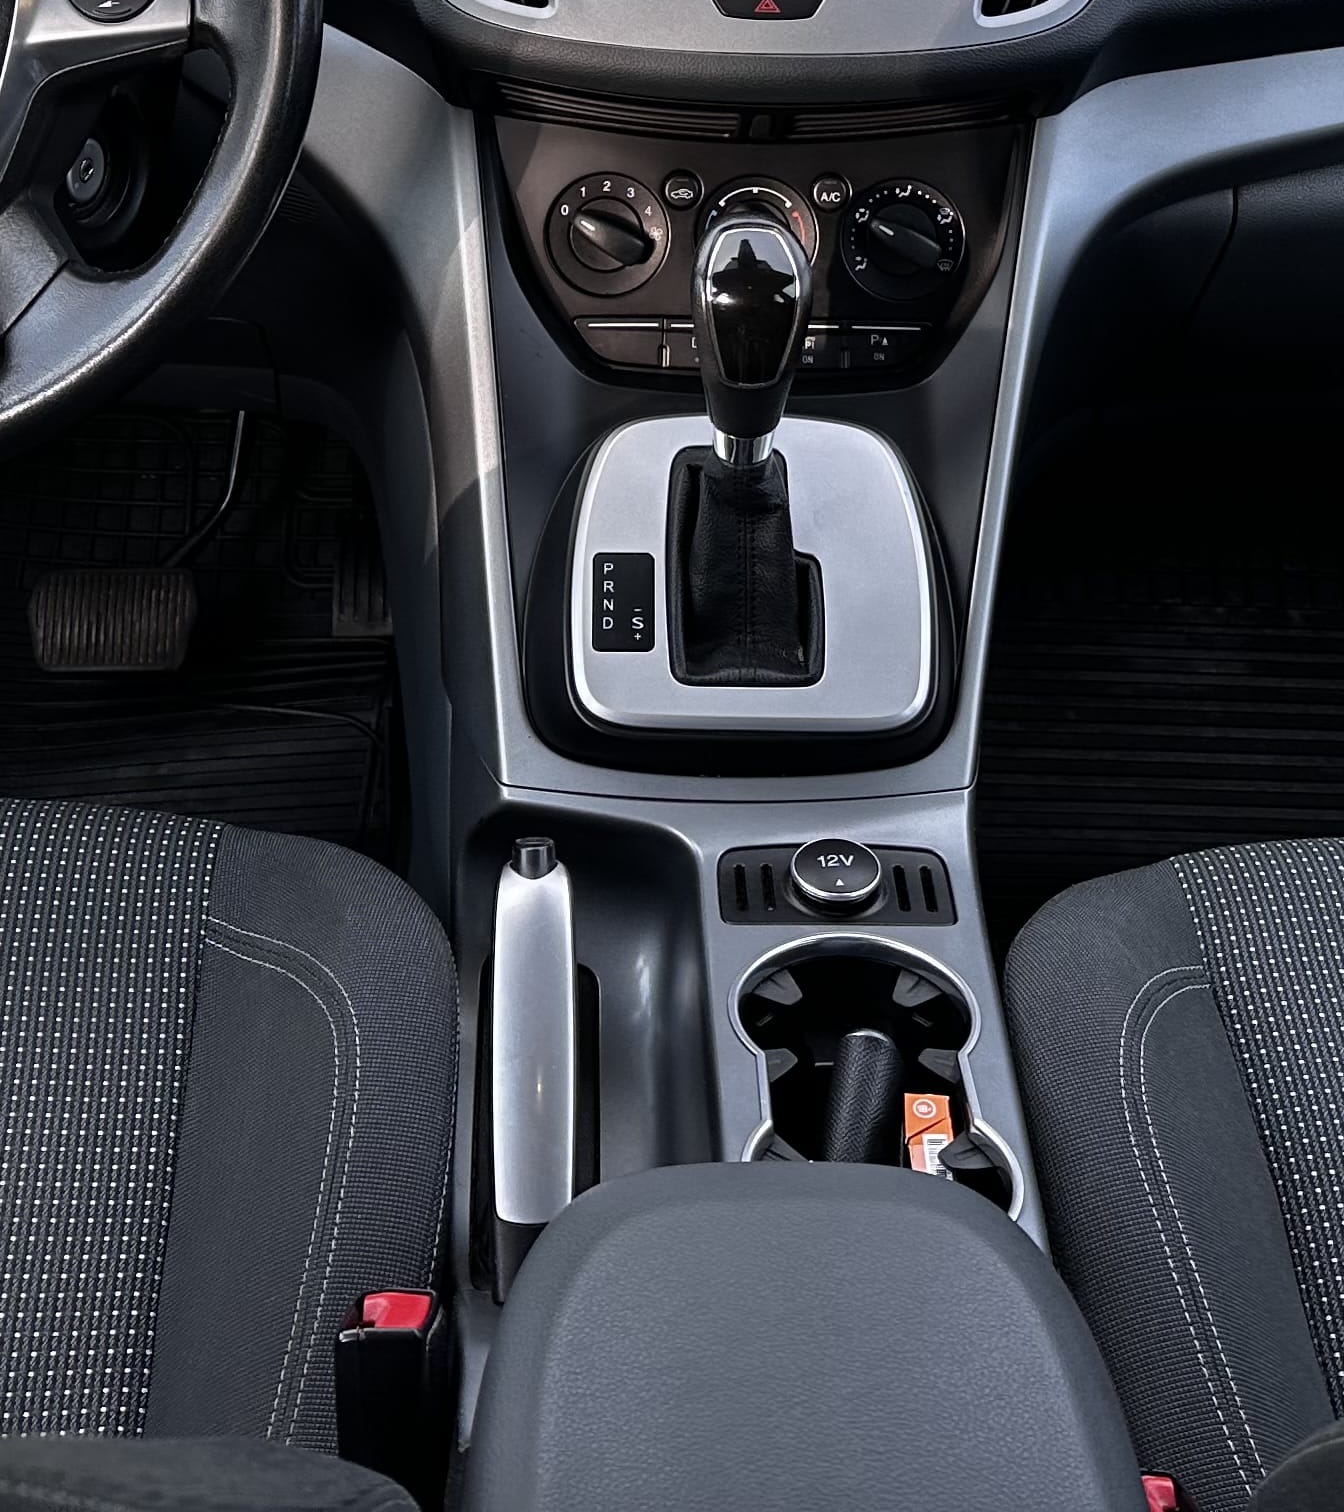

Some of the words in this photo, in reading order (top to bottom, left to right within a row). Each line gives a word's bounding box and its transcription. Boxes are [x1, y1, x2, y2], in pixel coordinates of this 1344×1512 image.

[602, 180, 612, 192] 2
[580, 187, 587, 198] 1
[626, 187, 636, 198] 3
[820, 191, 842, 203] A/C
[560, 204, 570, 216] 0
[644, 205, 654, 217] 4
[603, 562, 615, 575] P
[603, 580, 615, 593] R
[603, 598, 615, 611] N
[602, 616, 614, 630] D
[631, 616, 645, 629] S
[816, 854, 854, 867] 12V
